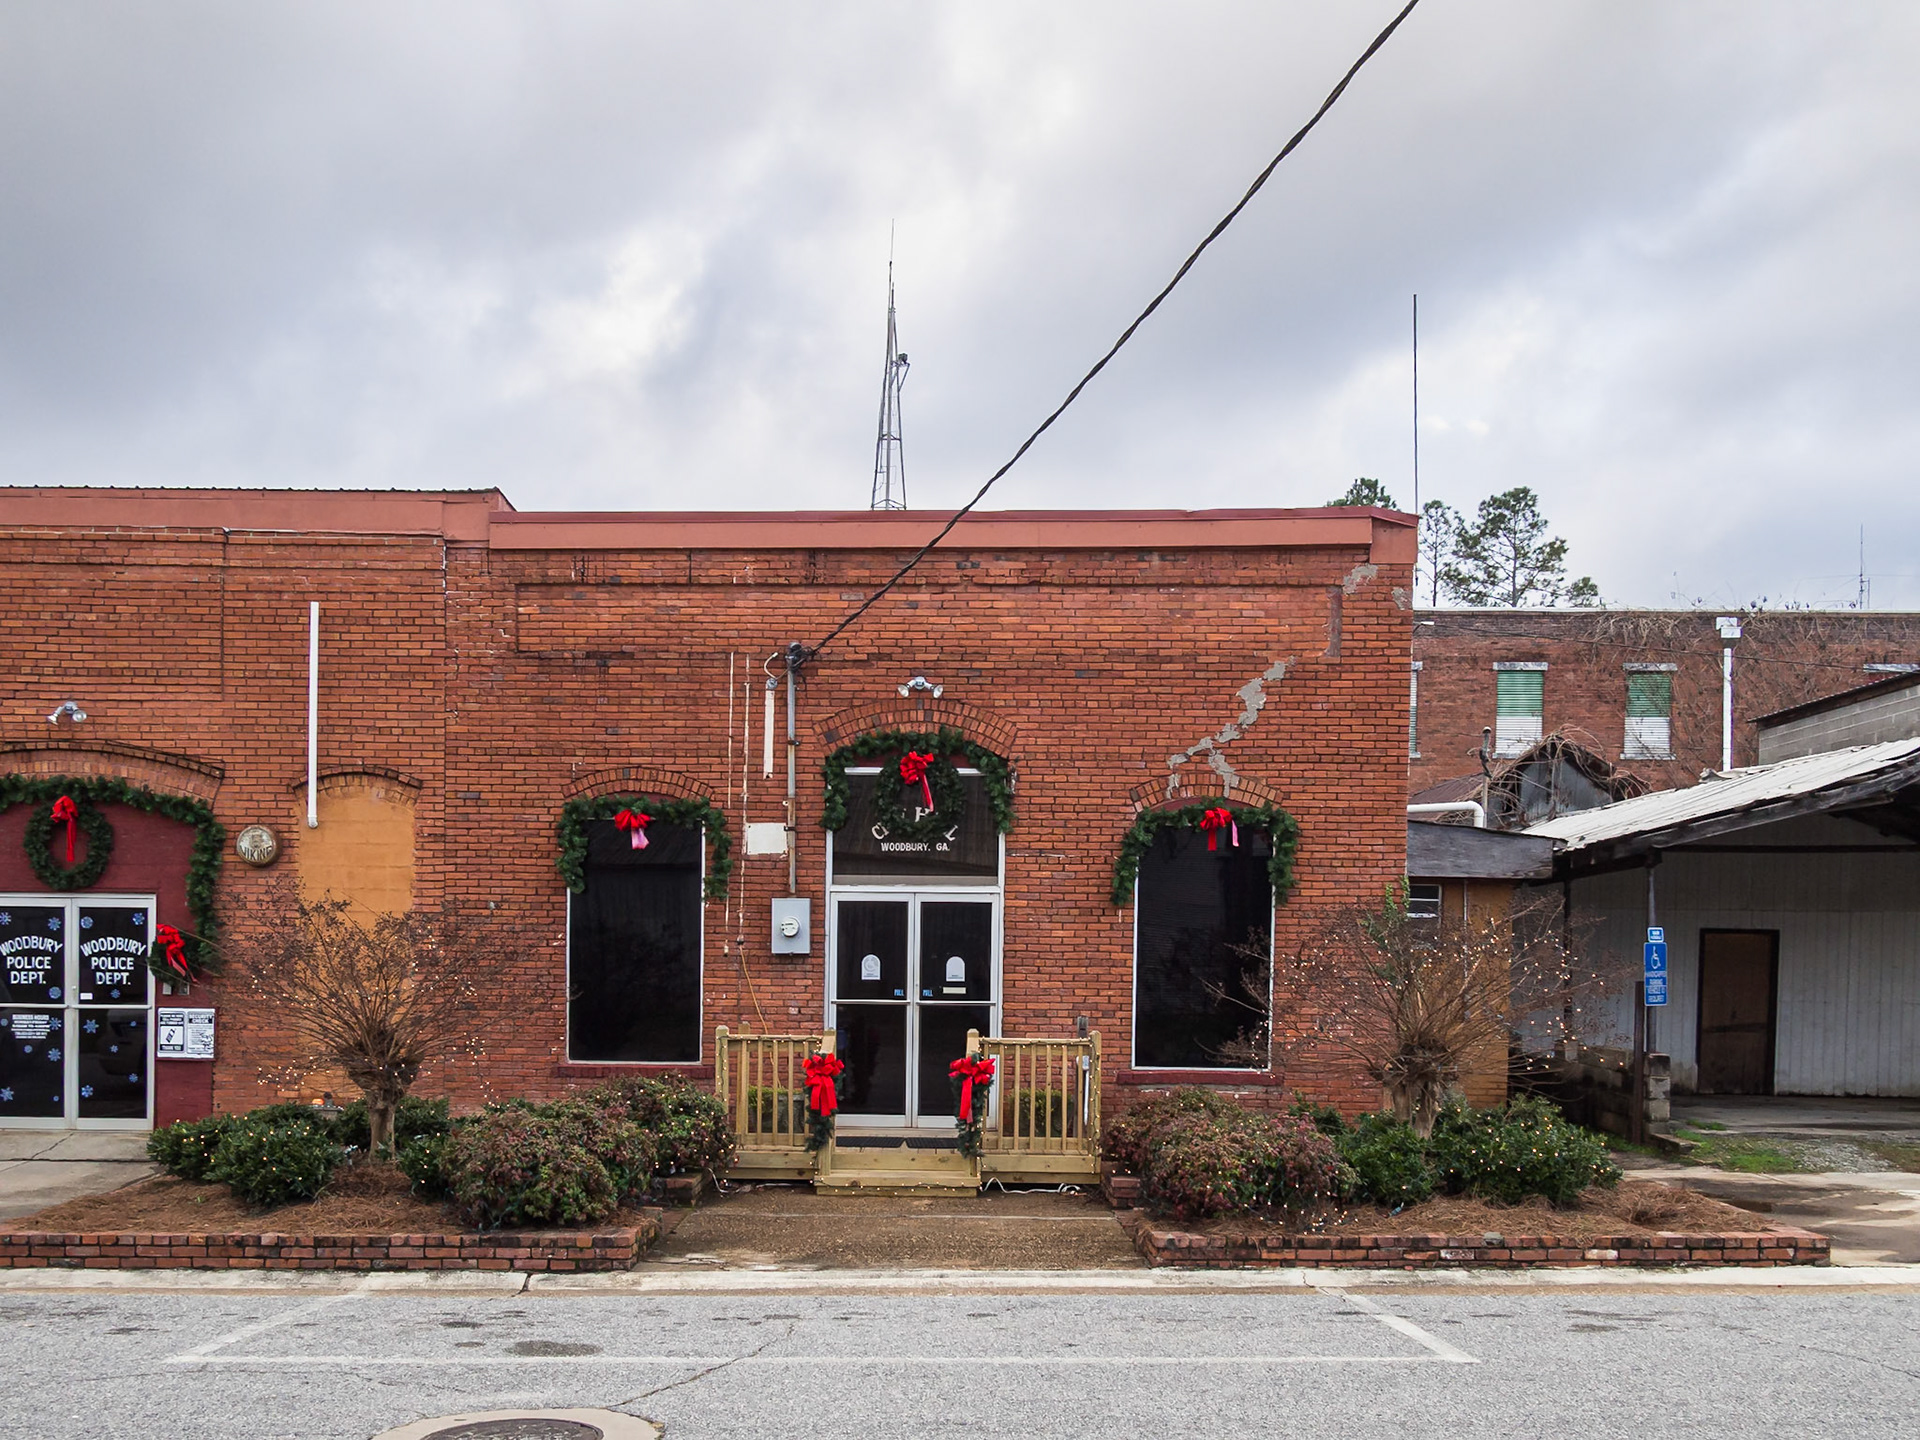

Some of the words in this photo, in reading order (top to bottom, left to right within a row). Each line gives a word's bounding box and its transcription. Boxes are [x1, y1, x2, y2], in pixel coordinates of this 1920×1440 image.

[240, 845, 272, 861] VIKING
[0, 936, 63, 956] WOODBURY
[80, 937, 147, 956] WOODBURY
[7, 956, 52, 969] POLICE
[91, 957, 134, 970] POLICE
[10, 971, 47, 984] DEPT.
[96, 972, 131, 985] DEPT.
